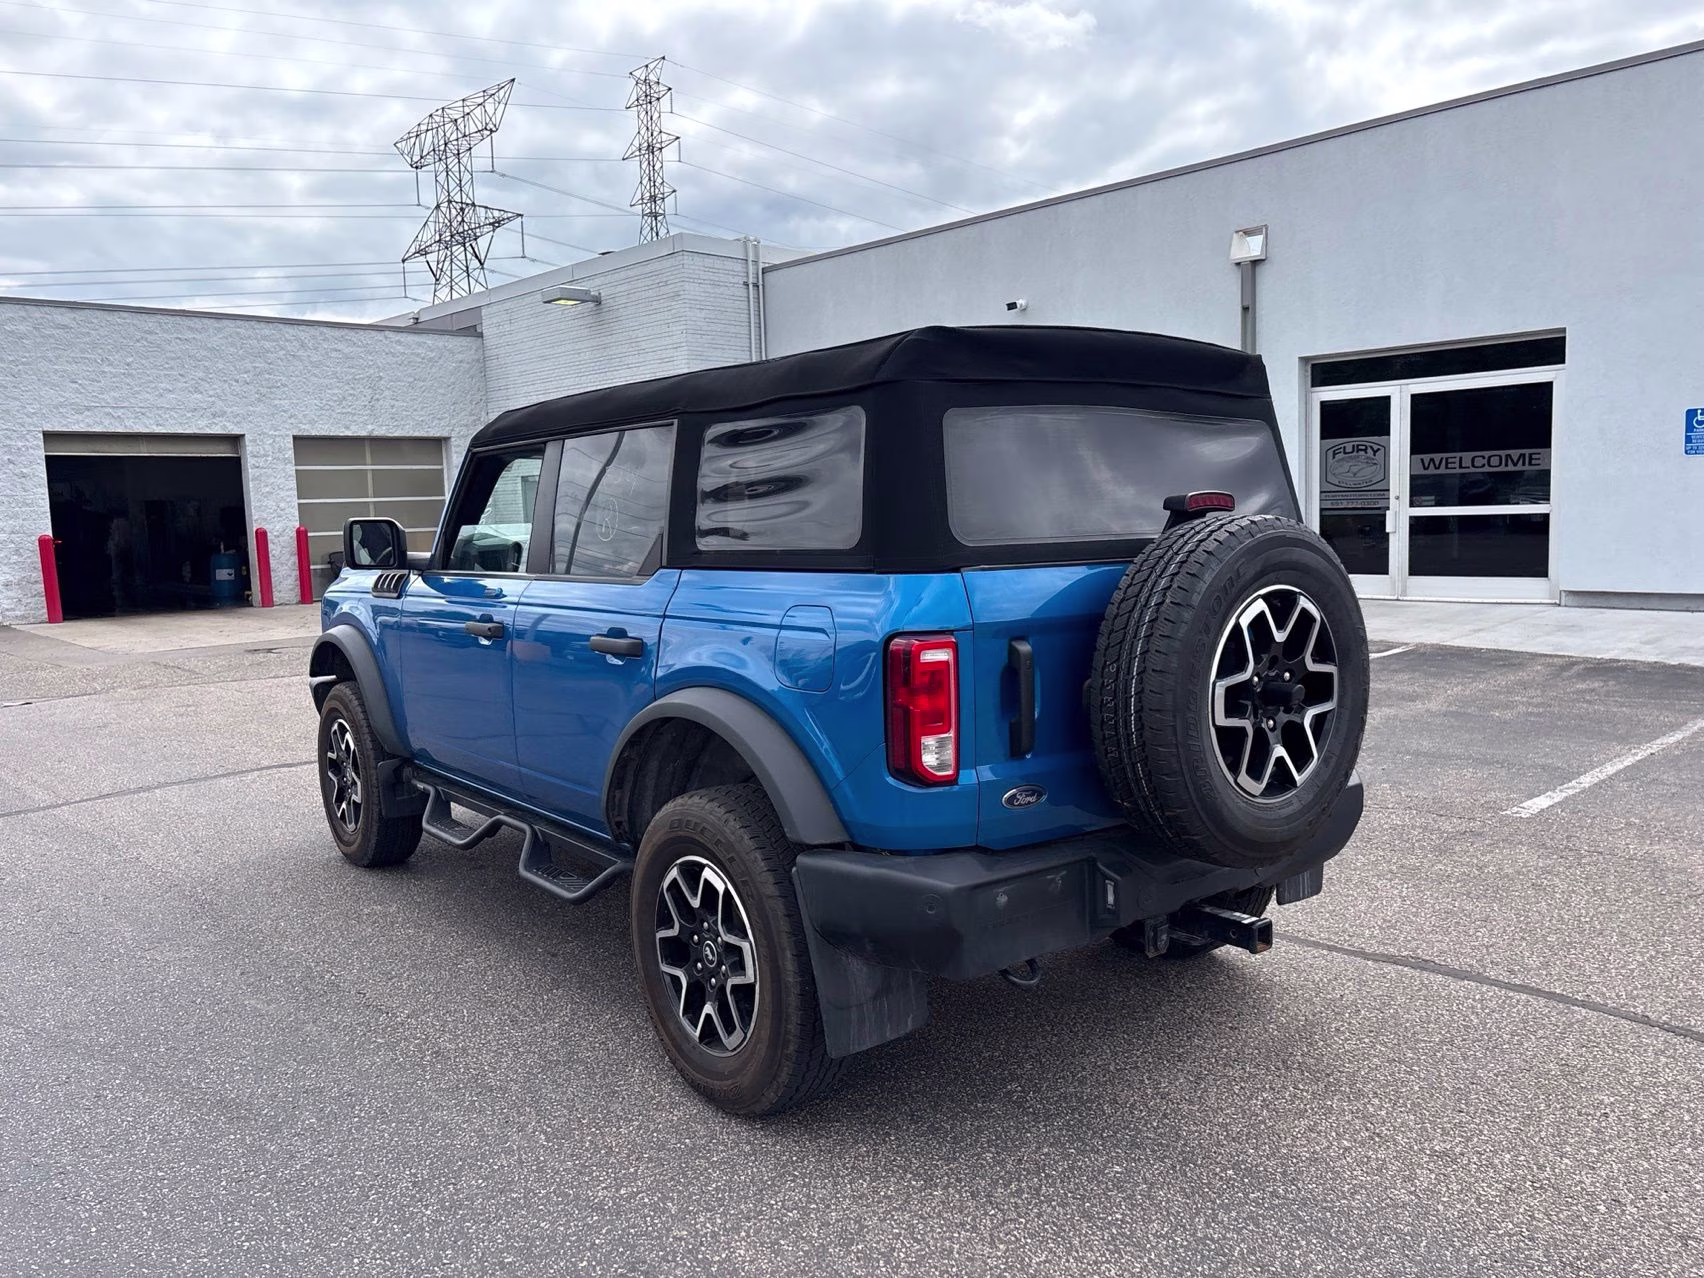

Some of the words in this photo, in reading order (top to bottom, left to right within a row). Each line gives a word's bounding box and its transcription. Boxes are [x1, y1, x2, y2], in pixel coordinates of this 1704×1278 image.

[1332, 444, 1381, 460] FURY
[1420, 452, 1542, 471] WELCOME
[1013, 790, 1038, 806] Ford
